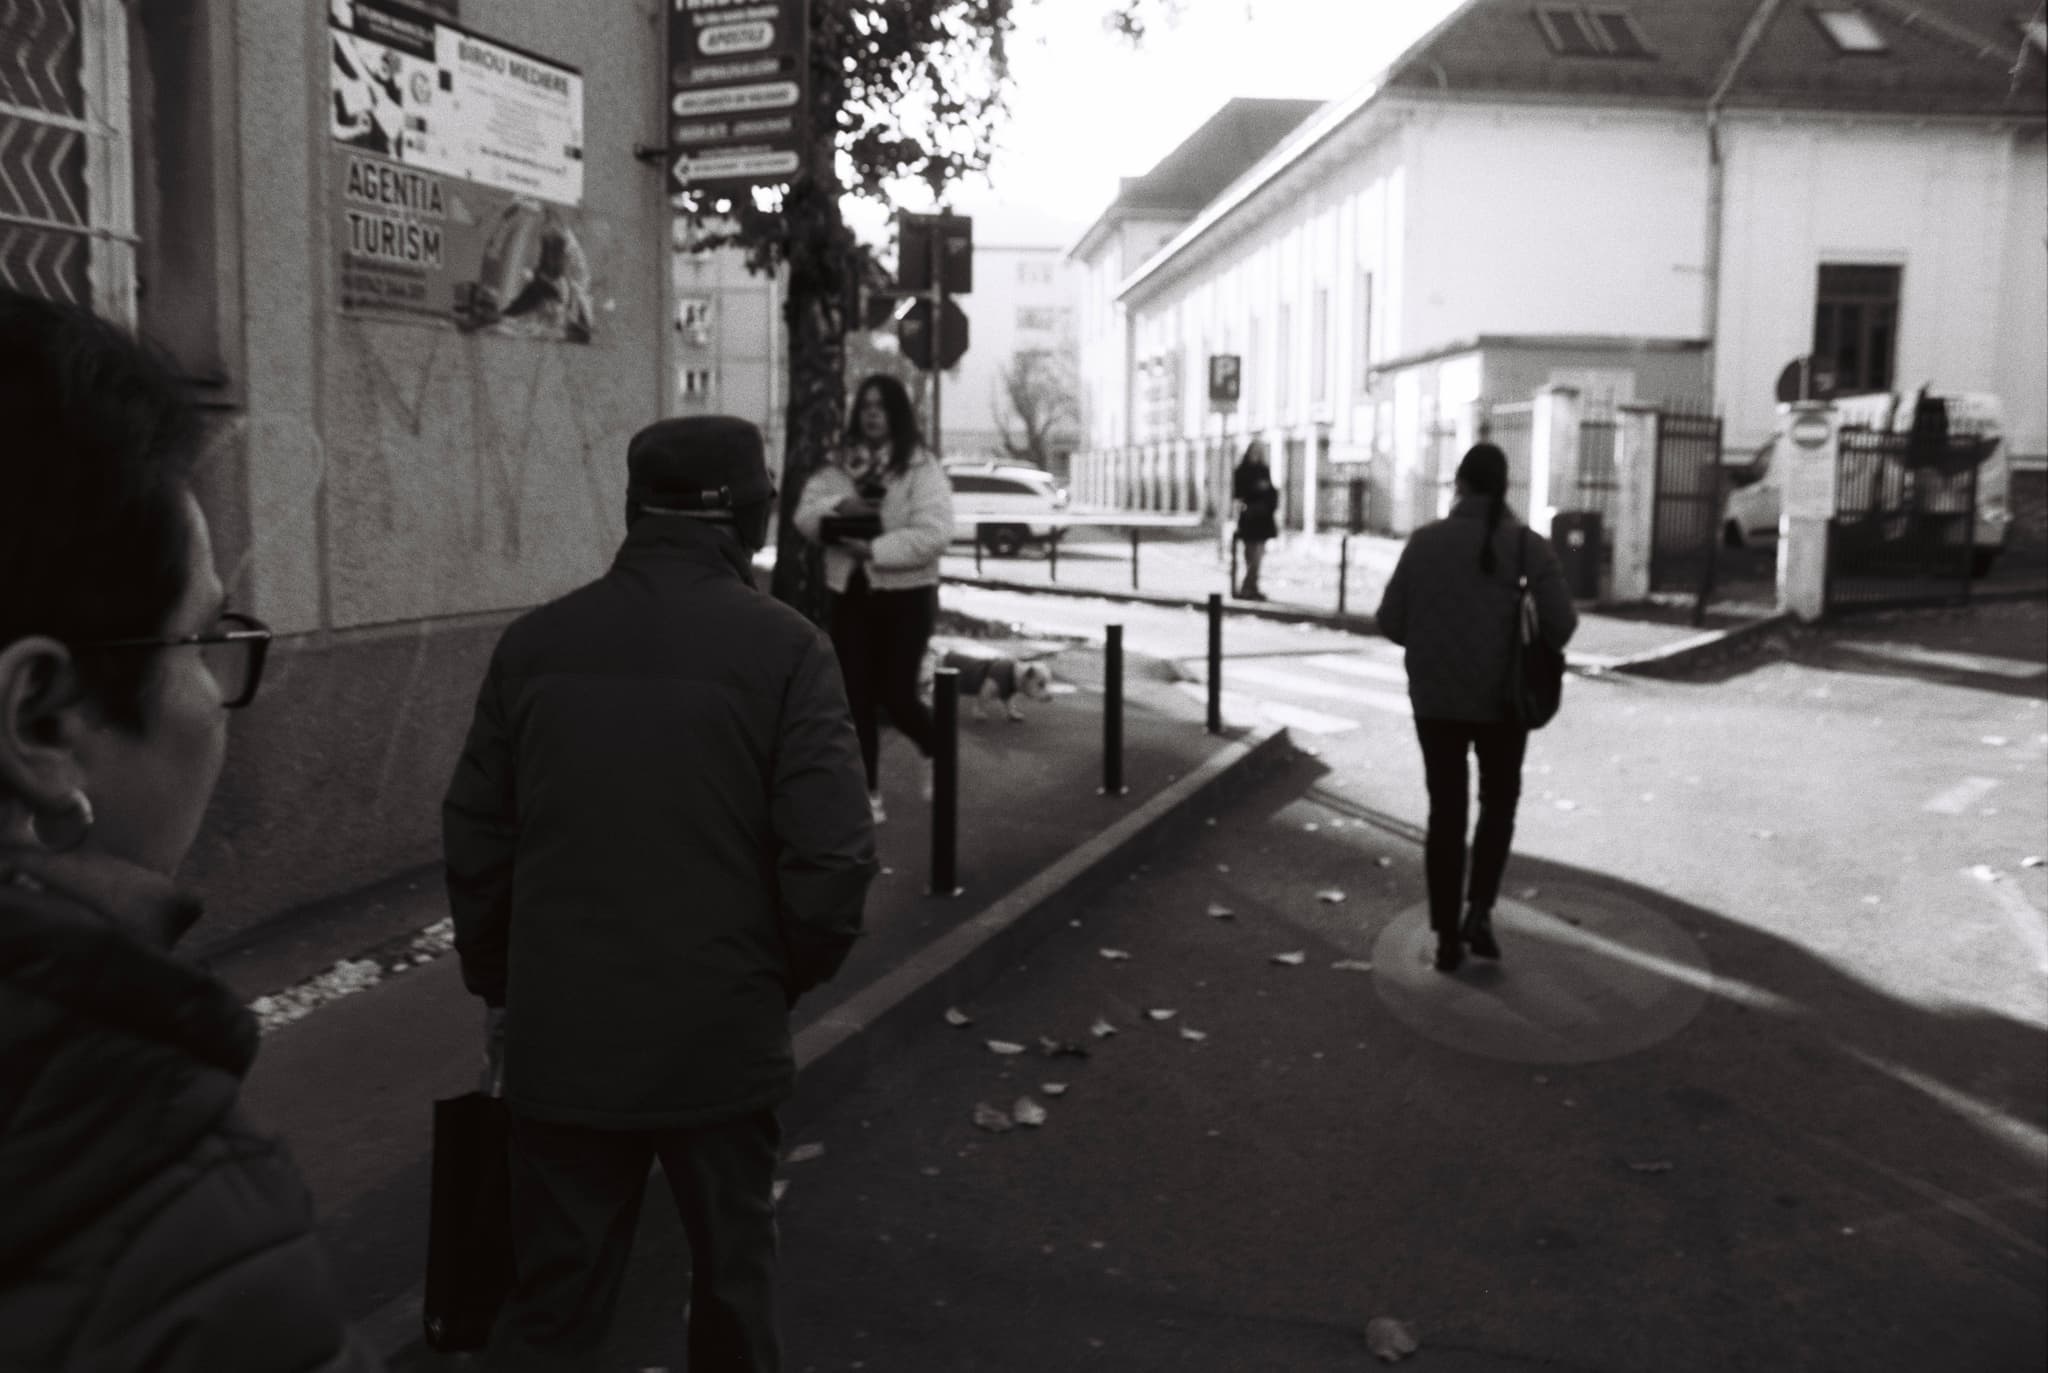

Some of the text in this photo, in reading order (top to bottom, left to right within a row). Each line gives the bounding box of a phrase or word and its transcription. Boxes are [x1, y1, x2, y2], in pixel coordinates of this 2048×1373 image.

[458, 41, 506, 74] BIROU
[348, 161, 443, 214] AGENTIA
[348, 213, 441, 264] TURISM
